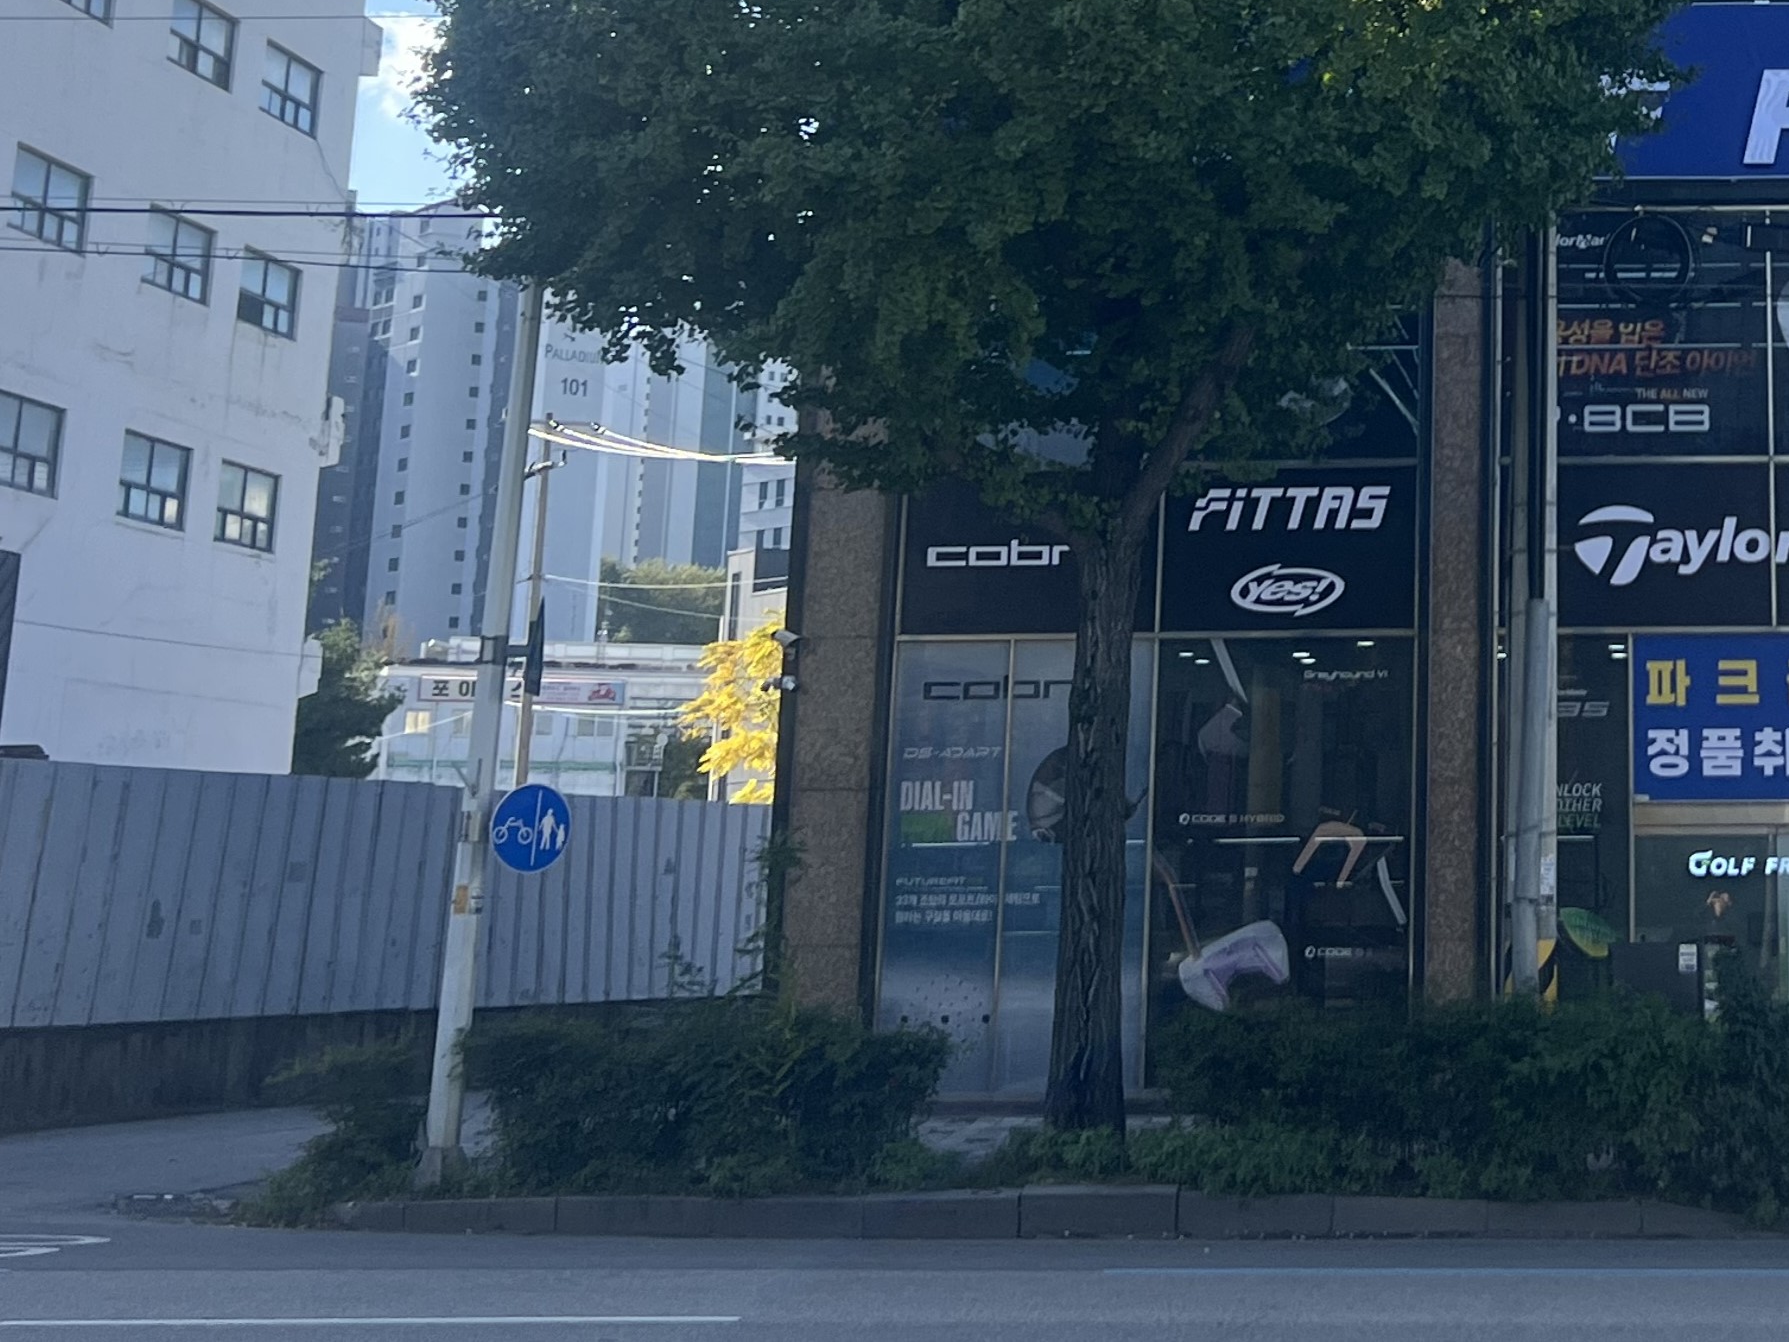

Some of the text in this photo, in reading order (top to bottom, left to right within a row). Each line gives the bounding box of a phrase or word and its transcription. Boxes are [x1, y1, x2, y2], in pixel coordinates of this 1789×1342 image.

[561, 377, 588, 397] 101
[900, 780, 975, 811] DIAL-IN
[956, 810, 1019, 842] GAME
[1688, 849, 1757, 878] GOLF
